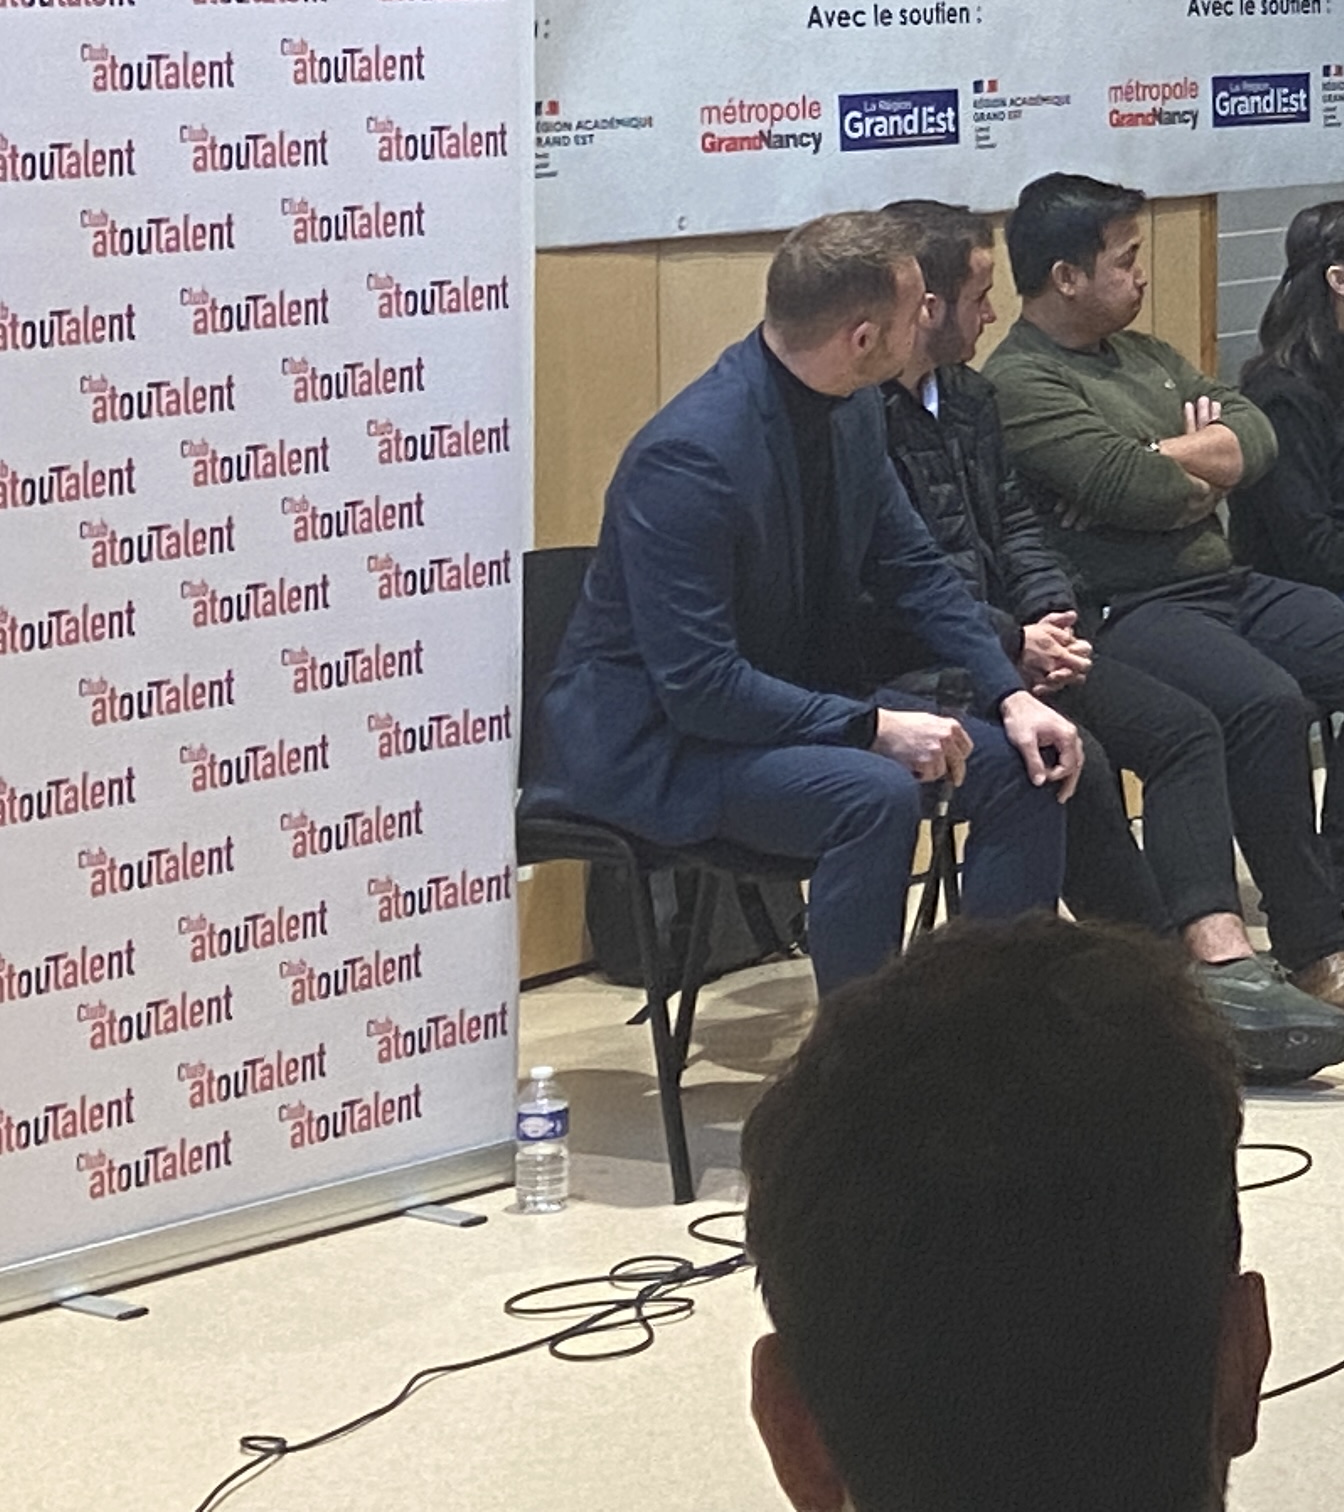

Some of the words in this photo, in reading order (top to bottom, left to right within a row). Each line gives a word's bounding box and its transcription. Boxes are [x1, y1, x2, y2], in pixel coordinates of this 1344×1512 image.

[807, 5, 866, 29] Avec
[873, 3, 893, 26] le
[900, 1, 970, 25] soutien
[81, 44, 109, 61] Club
[282, 38, 308, 55] Club
[94, 51, 234, 91] atouTalent
[294, 45, 424, 84] atouTalent
[1108, 77, 1199, 105] métropole
[700, 94, 821, 127] métropole
[181, 124, 208, 142] Club
[367, 117, 393, 133] Club
[193, 130, 328, 172] atouTalent
[379, 122, 507, 161] atouTalent
[701, 129, 823, 155] GrandNancy
[81, 210, 109, 227] Club
[282, 198, 308, 215] Club
[93, 214, 234, 257] atouTalent
[295, 202, 424, 243] atouTalent
[181, 286, 208, 305] Club
[368, 273, 394, 290] Club
[379, 275, 508, 318] atouTalent
[194, 289, 328, 334] atouTalent
[282, 357, 308, 375] Club
[295, 357, 424, 403] atouTalent
[81, 375, 109, 393] Club
[93, 375, 234, 423] atouTalent
[368, 419, 394, 436] Club
[379, 418, 510, 464] atouTalent
[181, 438, 208, 457] Club
[194, 437, 329, 486] atouTalent
[282, 495, 308, 514] Club
[295, 493, 424, 542] atouTalent
[80, 518, 109, 539] Club
[93, 516, 234, 567] atouTalent
[368, 554, 394, 572] Club
[379, 550, 510, 599] atouTalent
[181, 579, 209, 598] Club
[194, 574, 330, 627] atouTalent
[282, 647, 308, 665] Club
[294, 640, 423, 693] atouTalent
[80, 676, 109, 696] Club
[92, 669, 234, 726] atouTalent
[368, 713, 394, 732] Club
[380, 706, 510, 759] atouTalent
[181, 744, 208, 763] Club
[193, 735, 329, 791] atouTalent
[281, 810, 307, 830] Club
[293, 801, 422, 858] atouTalent
[79, 847, 108, 868] Club
[91, 836, 233, 897] atouTalent
[367, 876, 394, 895] Club
[379, 866, 510, 922] atouTalent
[179, 914, 206, 934] Club
[191, 901, 327, 962] atouTalent
[280, 956, 306, 978] Club
[292, 944, 421, 1005] atouTalent
[78, 1000, 107, 1022] Club
[91, 985, 232, 1049] atouTalent
[366, 1017, 392, 1037] Club
[378, 1003, 507, 1063] atouTalent
[178, 1061, 205, 1081] Club
[190, 1043, 325, 1108] atouTalent
[279, 1100, 305, 1122] Club
[291, 1084, 421, 1148] atouTalent
[77, 1149, 106, 1171] Club
[90, 1131, 231, 1199] atouTalent
